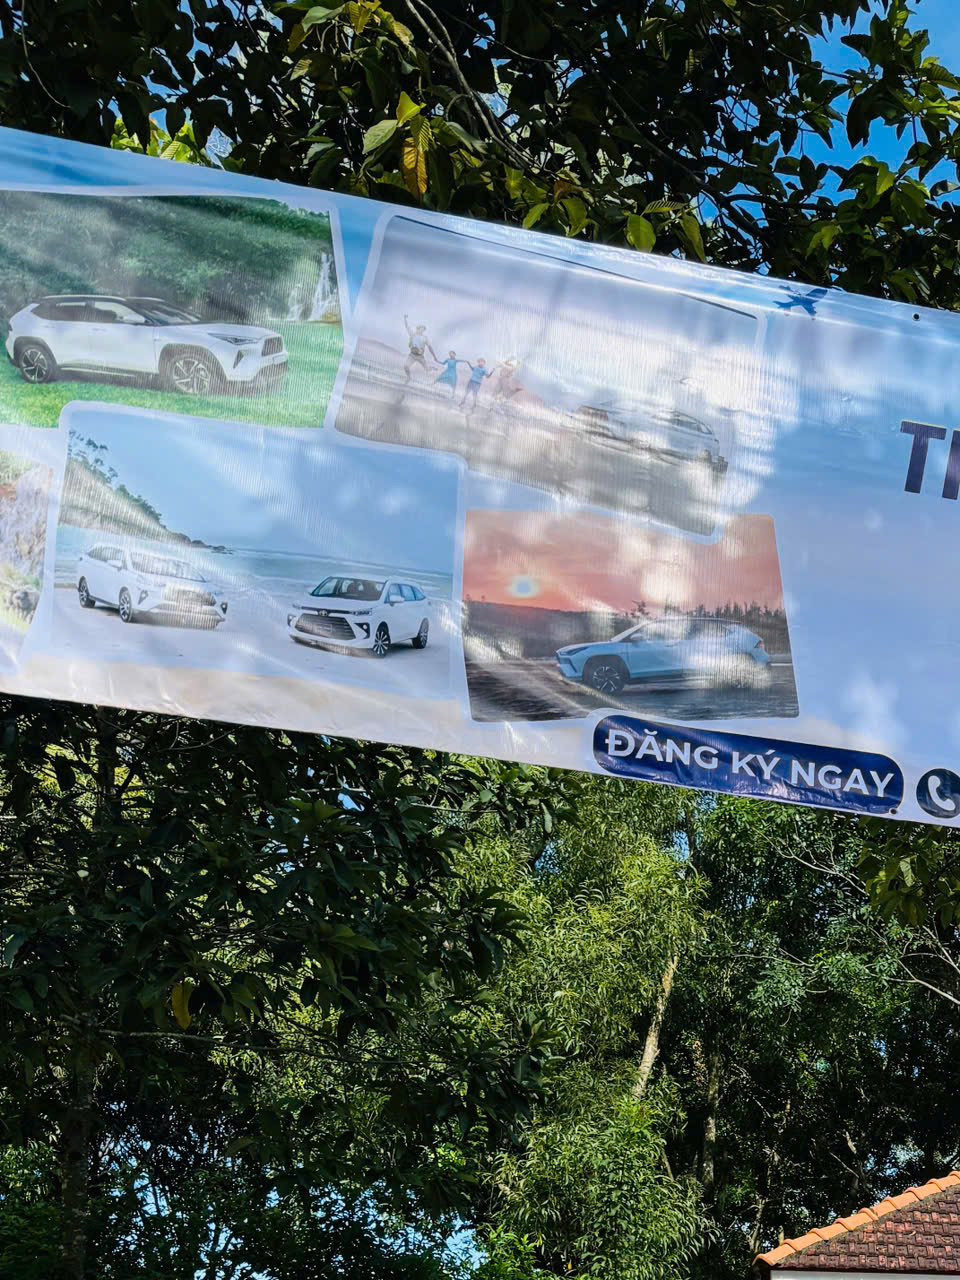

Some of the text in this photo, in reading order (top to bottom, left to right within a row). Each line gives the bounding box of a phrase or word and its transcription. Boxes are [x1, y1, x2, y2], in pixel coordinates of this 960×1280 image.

[607, 727, 894, 799] ĐĂNG KÝ NGAY
